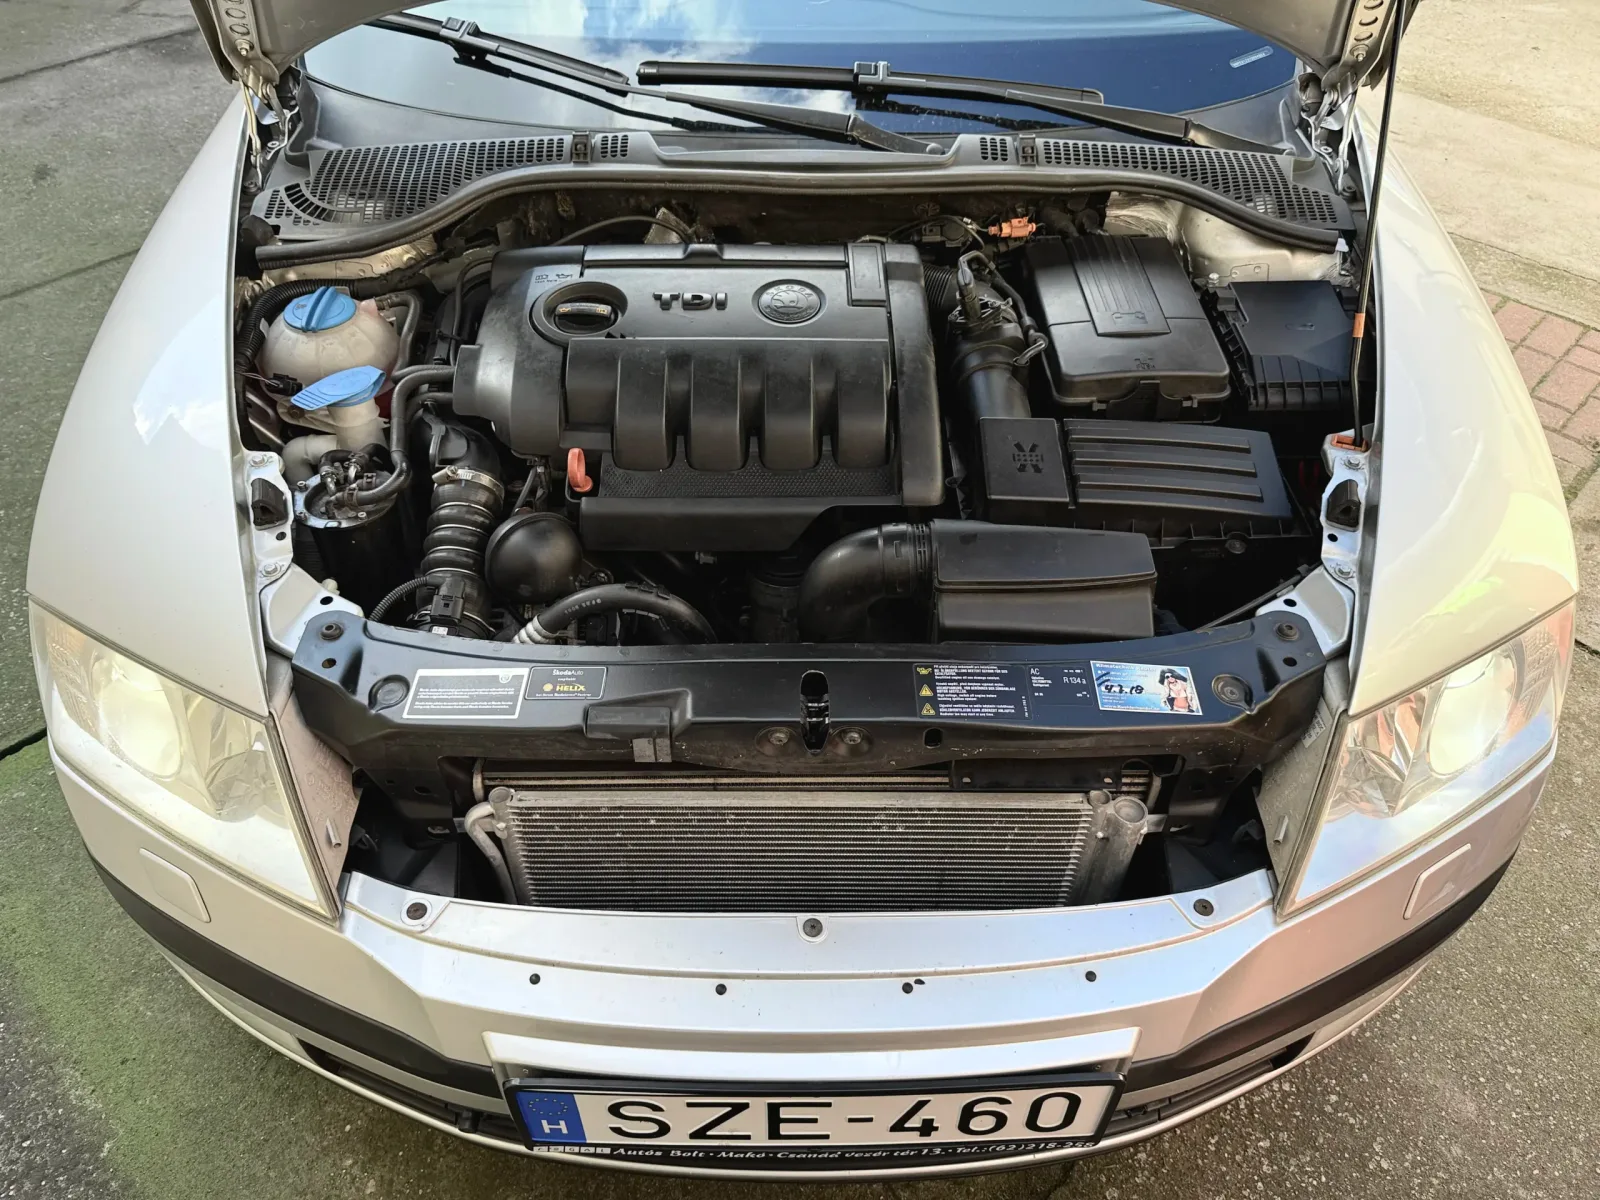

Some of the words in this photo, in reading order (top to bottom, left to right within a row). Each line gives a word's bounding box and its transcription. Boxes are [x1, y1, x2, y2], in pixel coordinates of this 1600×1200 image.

[652, 292, 728, 311] TDI
[556, 684, 586, 692] HELIX
[607, 1091, 1081, 1139] SZE-460
[541, 1119, 568, 1134] H
